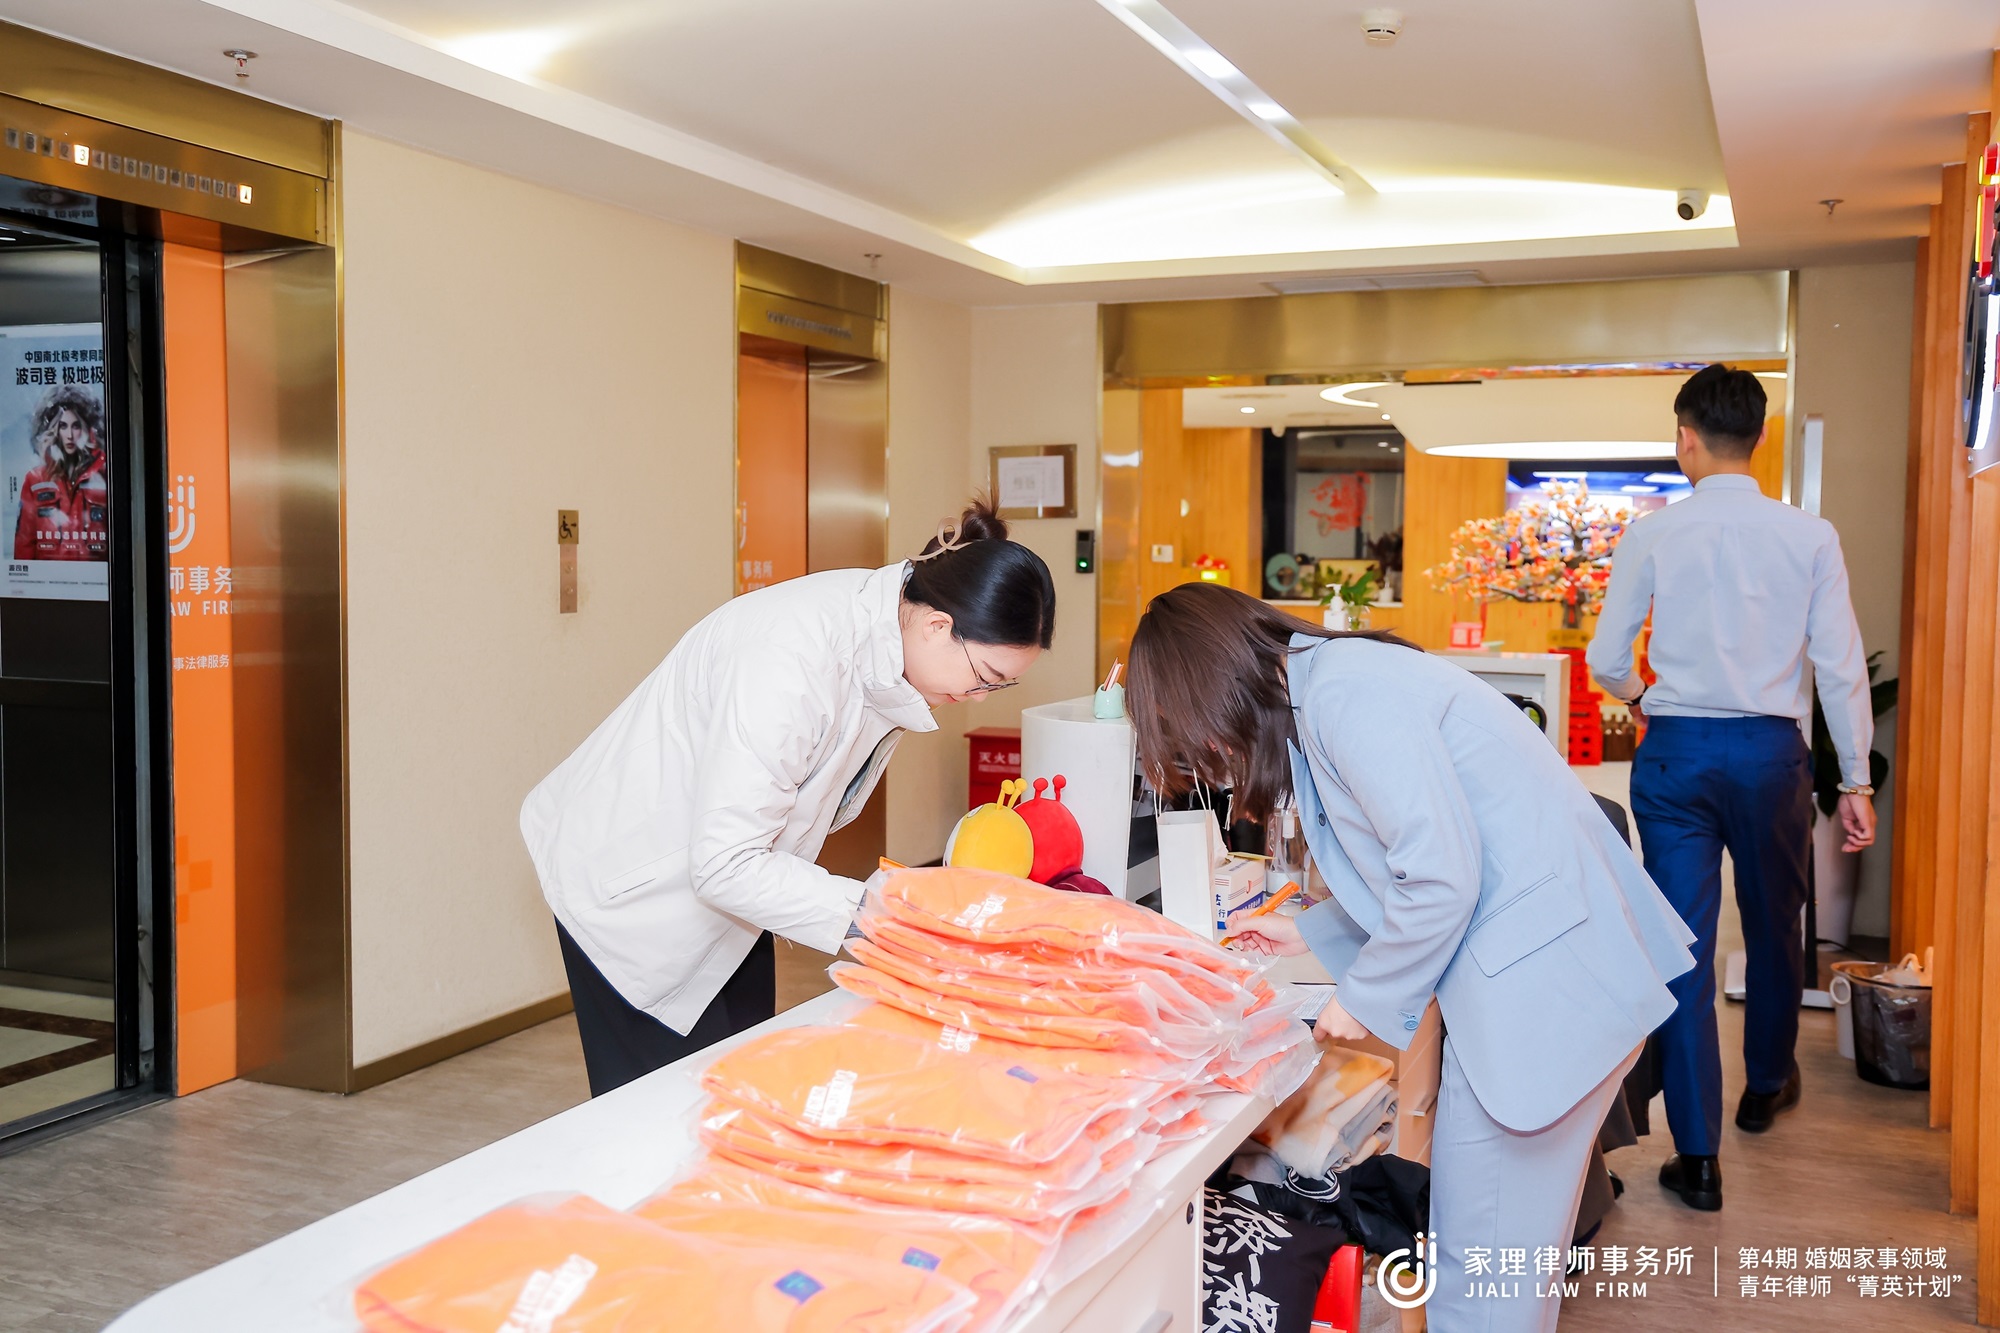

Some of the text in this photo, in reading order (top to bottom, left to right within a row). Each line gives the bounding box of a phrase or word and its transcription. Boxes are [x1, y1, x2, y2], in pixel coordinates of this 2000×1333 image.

[187, 173, 195, 188] 10
[215, 180, 223, 194] 12
[229, 185, 237, 198] 13
[16, 366, 105, 385] 波司登 极地极
[203, 600, 233, 615] FIR
[173, 654, 229, 671] 事法律服务
